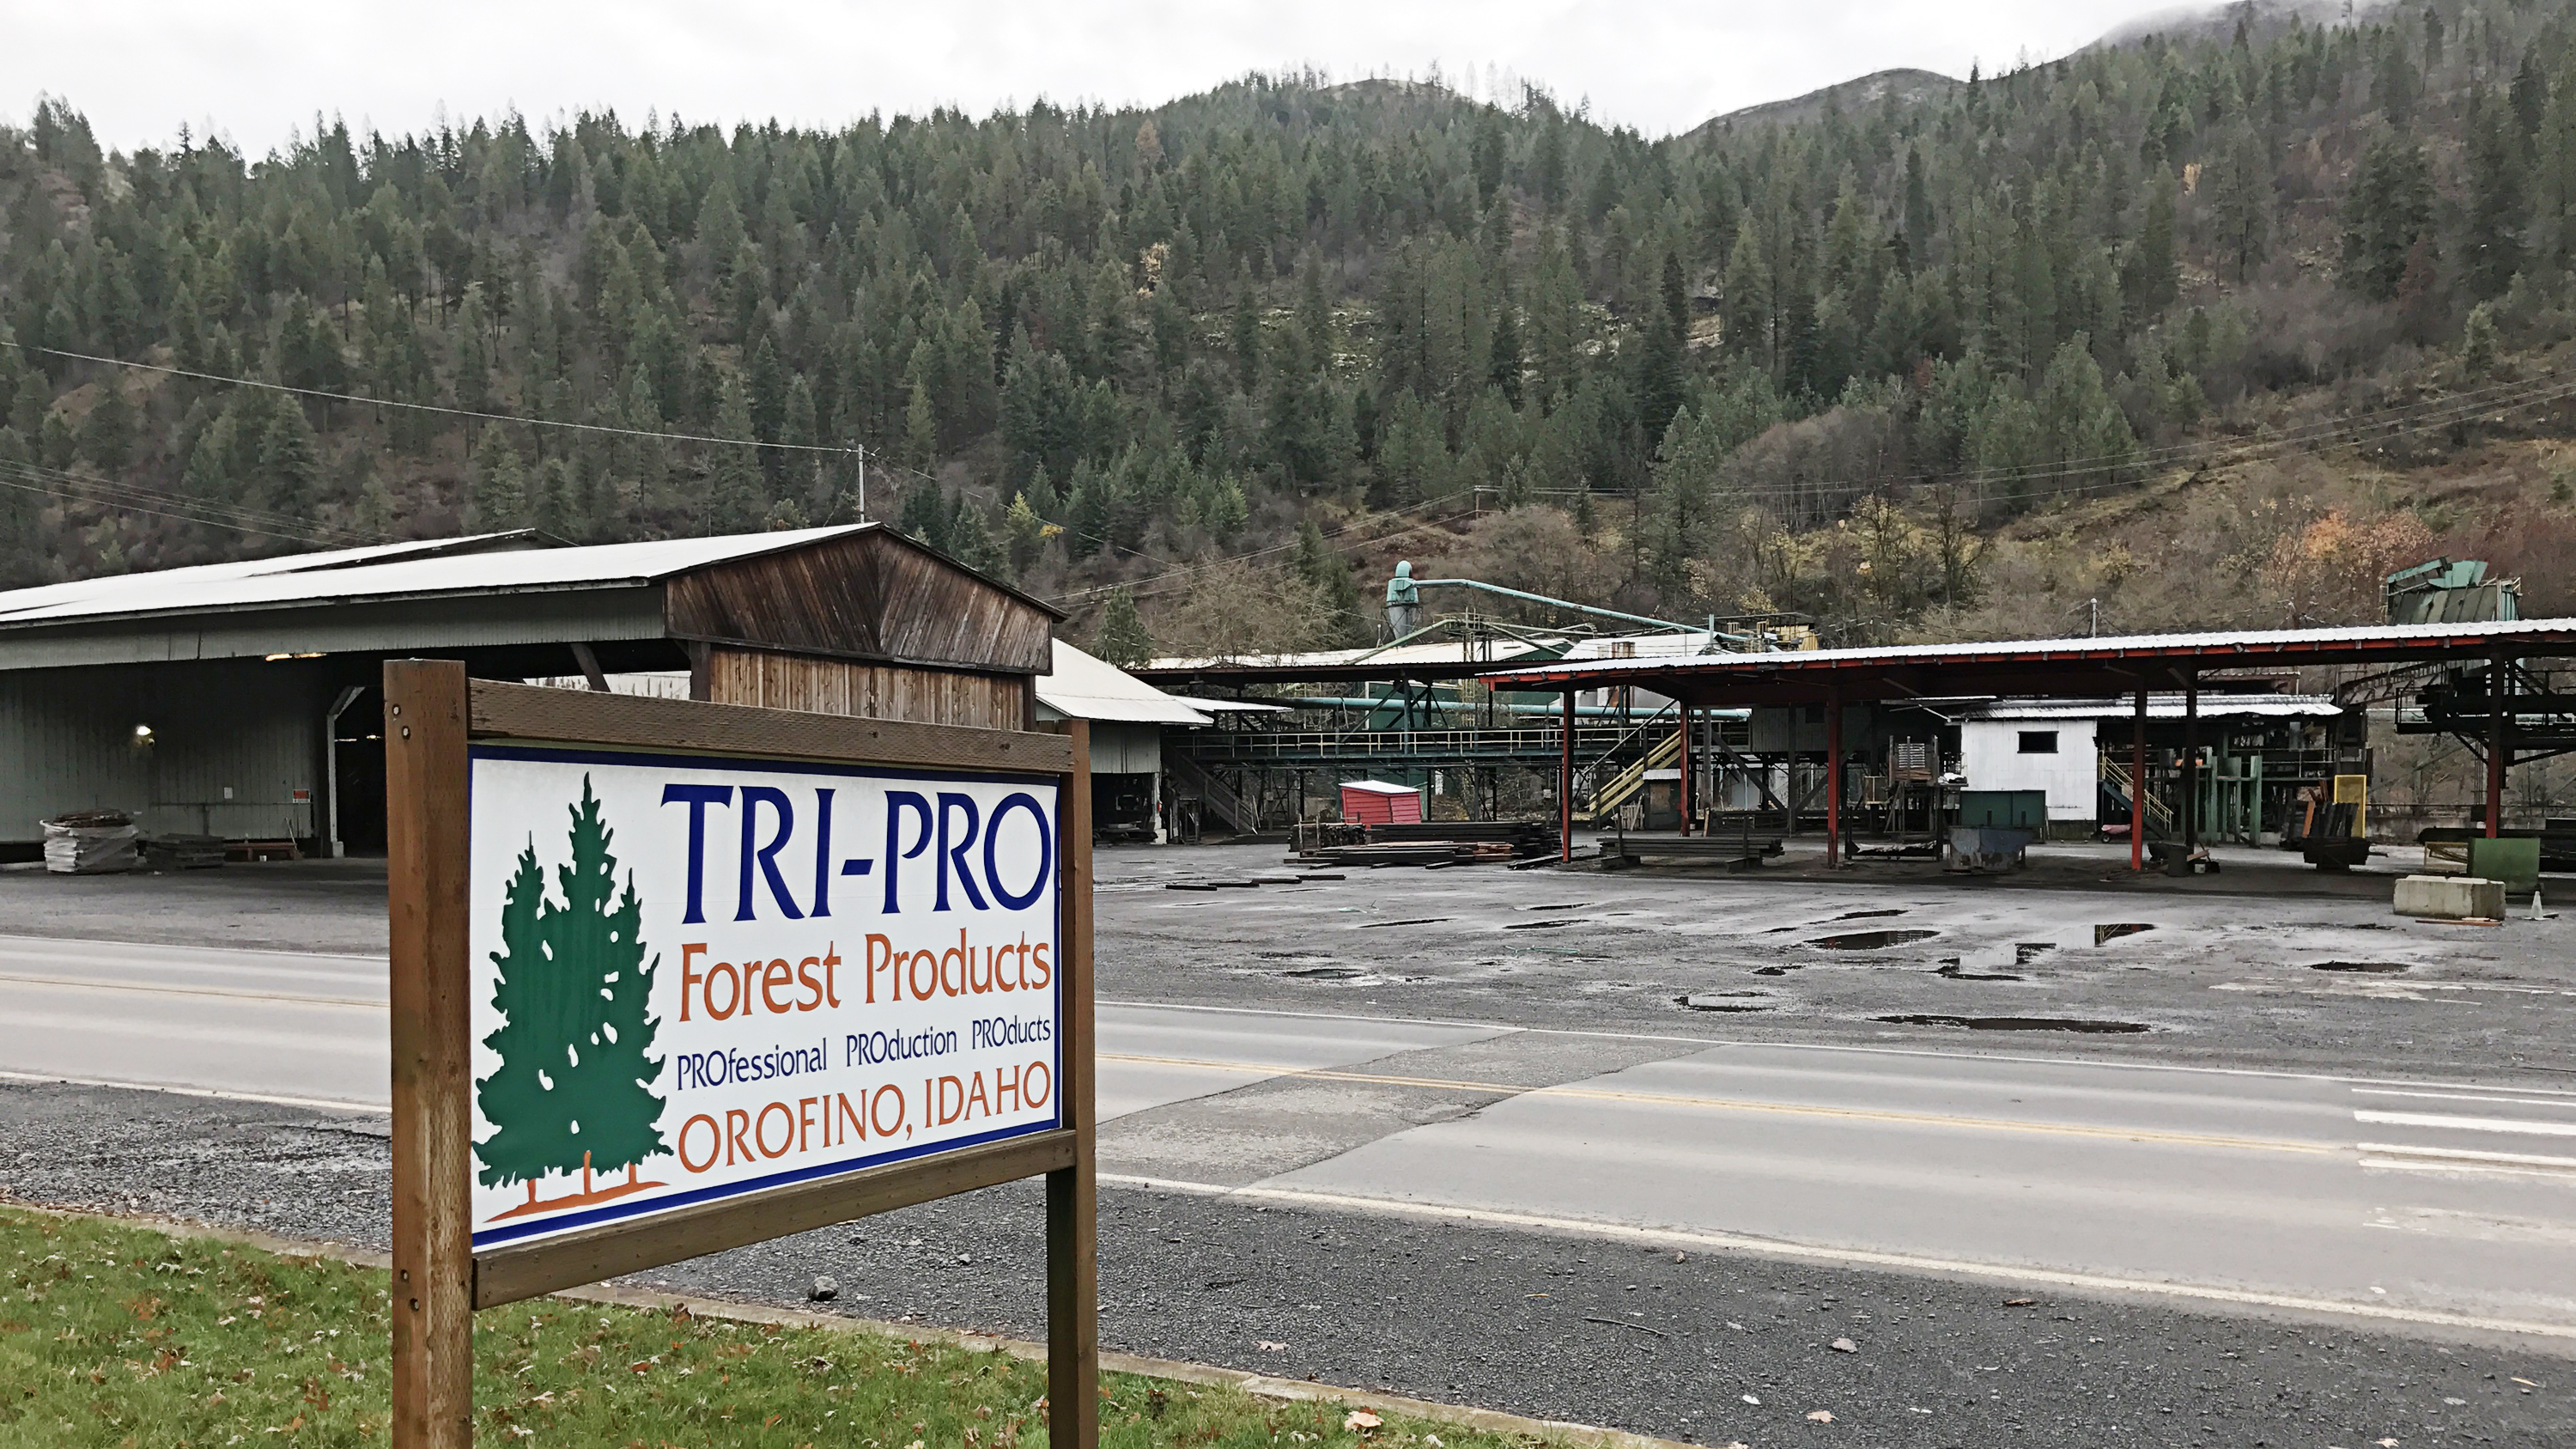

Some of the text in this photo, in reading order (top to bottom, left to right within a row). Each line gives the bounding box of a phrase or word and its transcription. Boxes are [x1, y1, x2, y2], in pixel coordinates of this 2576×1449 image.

[660, 783, 1051, 924] TRI-PRO
[679, 928, 1051, 1022] Forest Products
[677, 1014, 1051, 1090] PROfessional PROduction PROducts
[677, 1061, 1051, 1174] OROFINO, IDAHO
